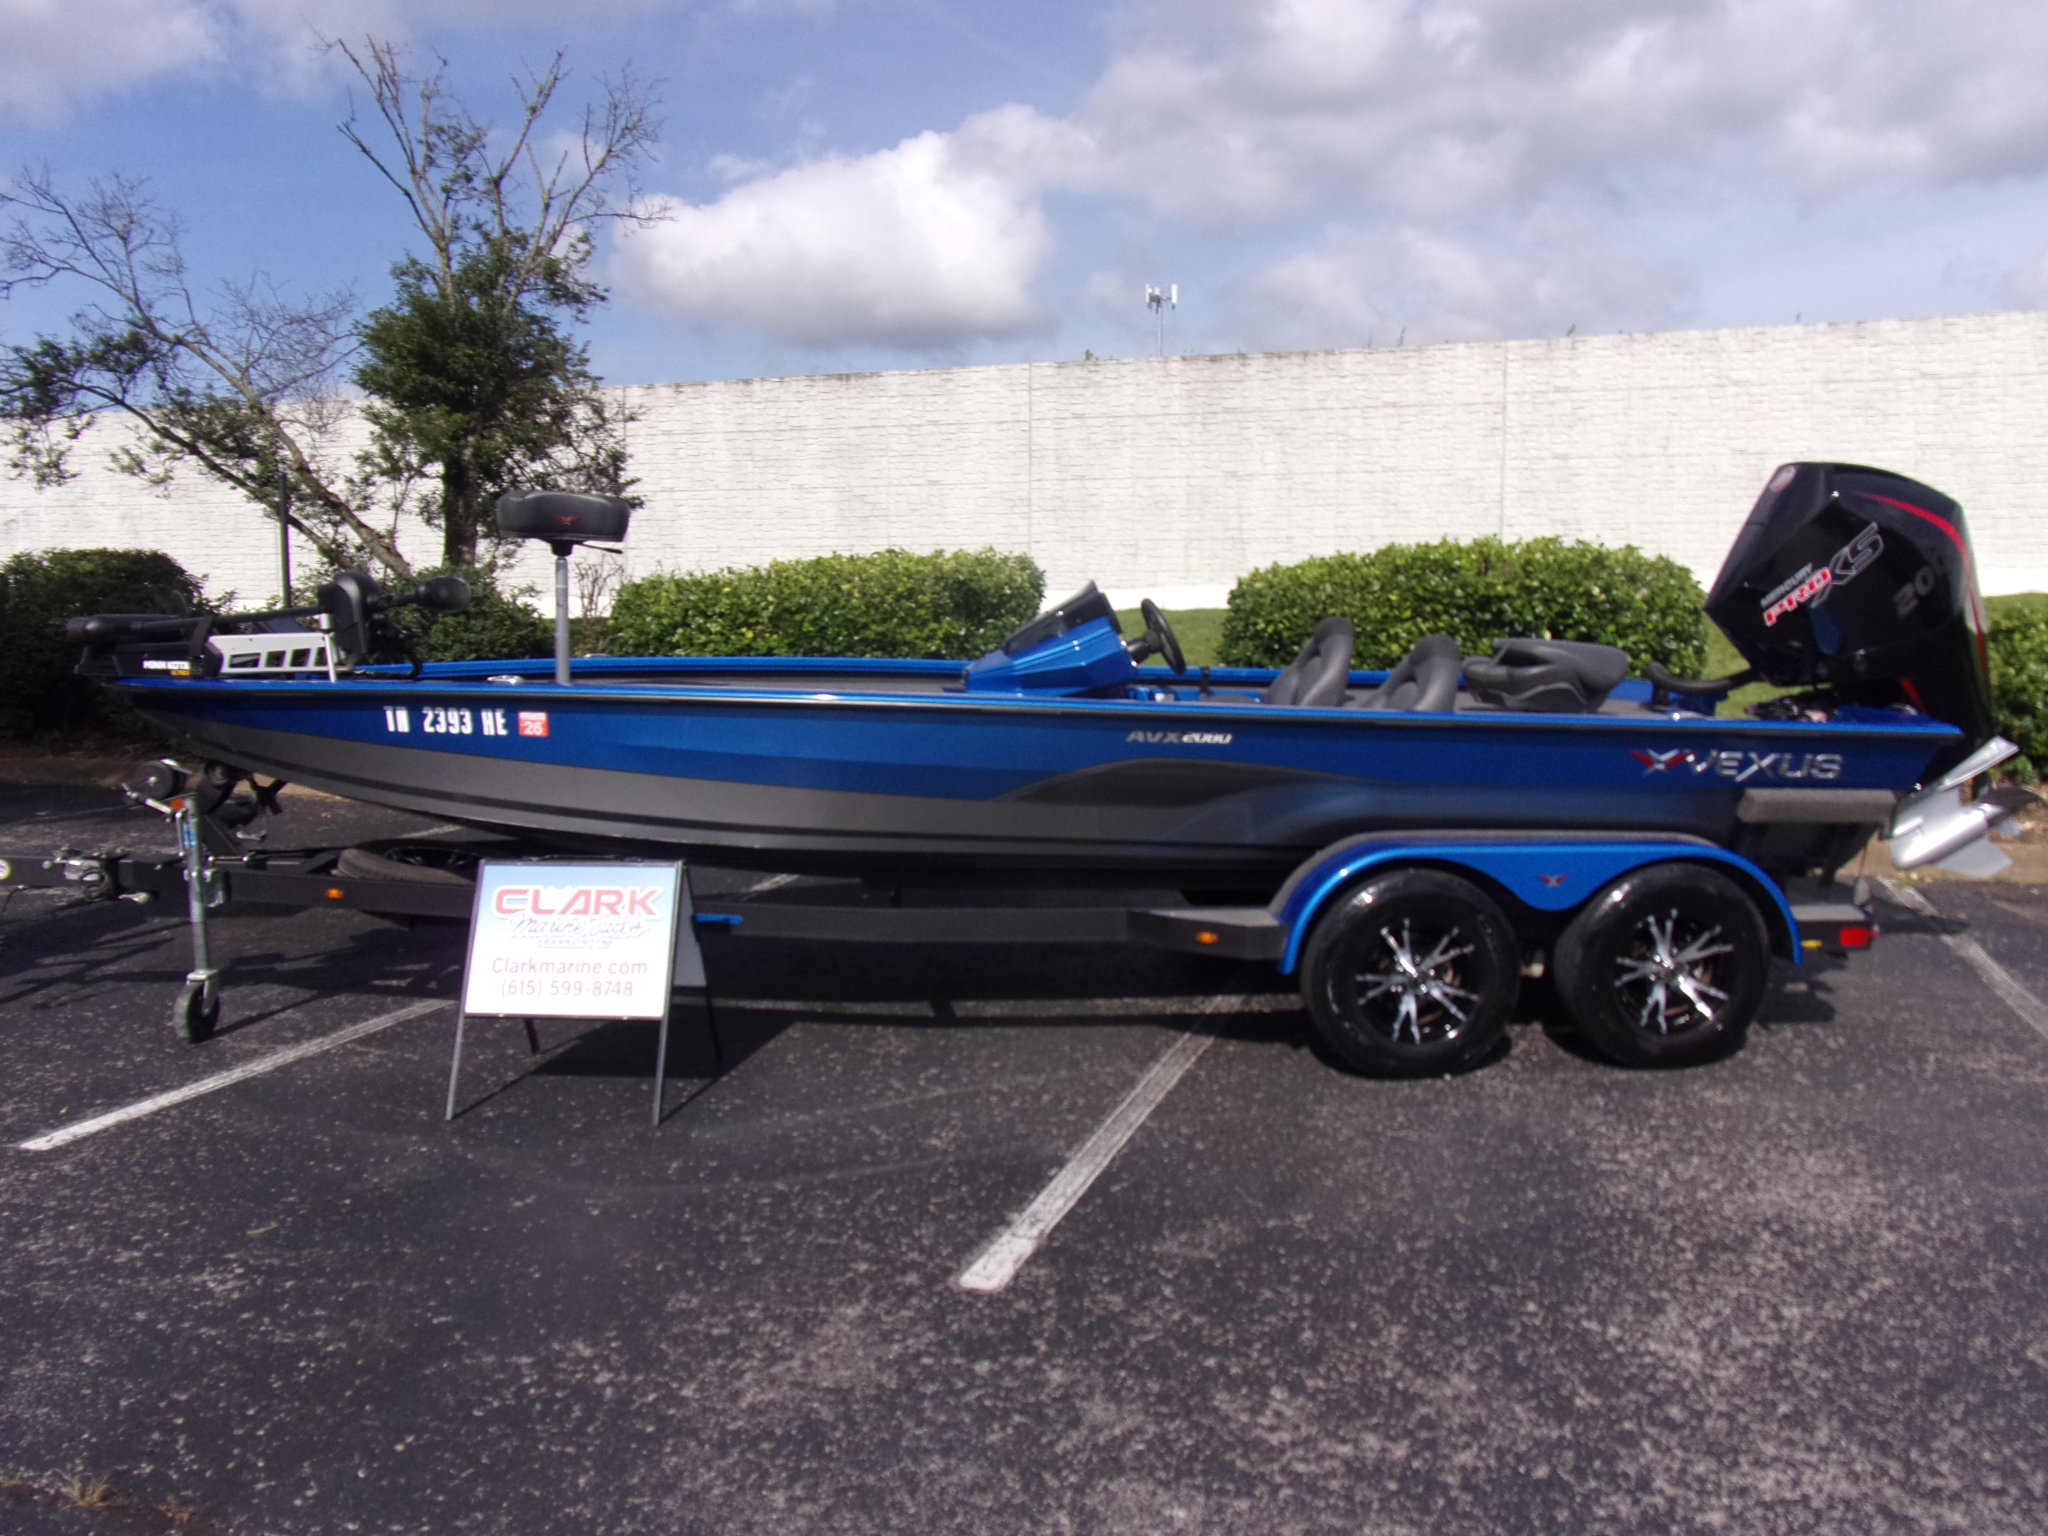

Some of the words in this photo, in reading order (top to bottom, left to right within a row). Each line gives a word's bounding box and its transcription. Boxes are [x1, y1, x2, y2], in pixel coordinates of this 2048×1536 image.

[422, 706, 474, 735] 2393
[481, 708, 508, 736] HE
[1684, 749, 1842, 782] VEXUS
[495, 889, 657, 915] CLARK
[492, 957, 647, 975] Clarkmarine.com
[501, 979, 542, 998] (615)
[550, 981, 633, 997] 599-8748
